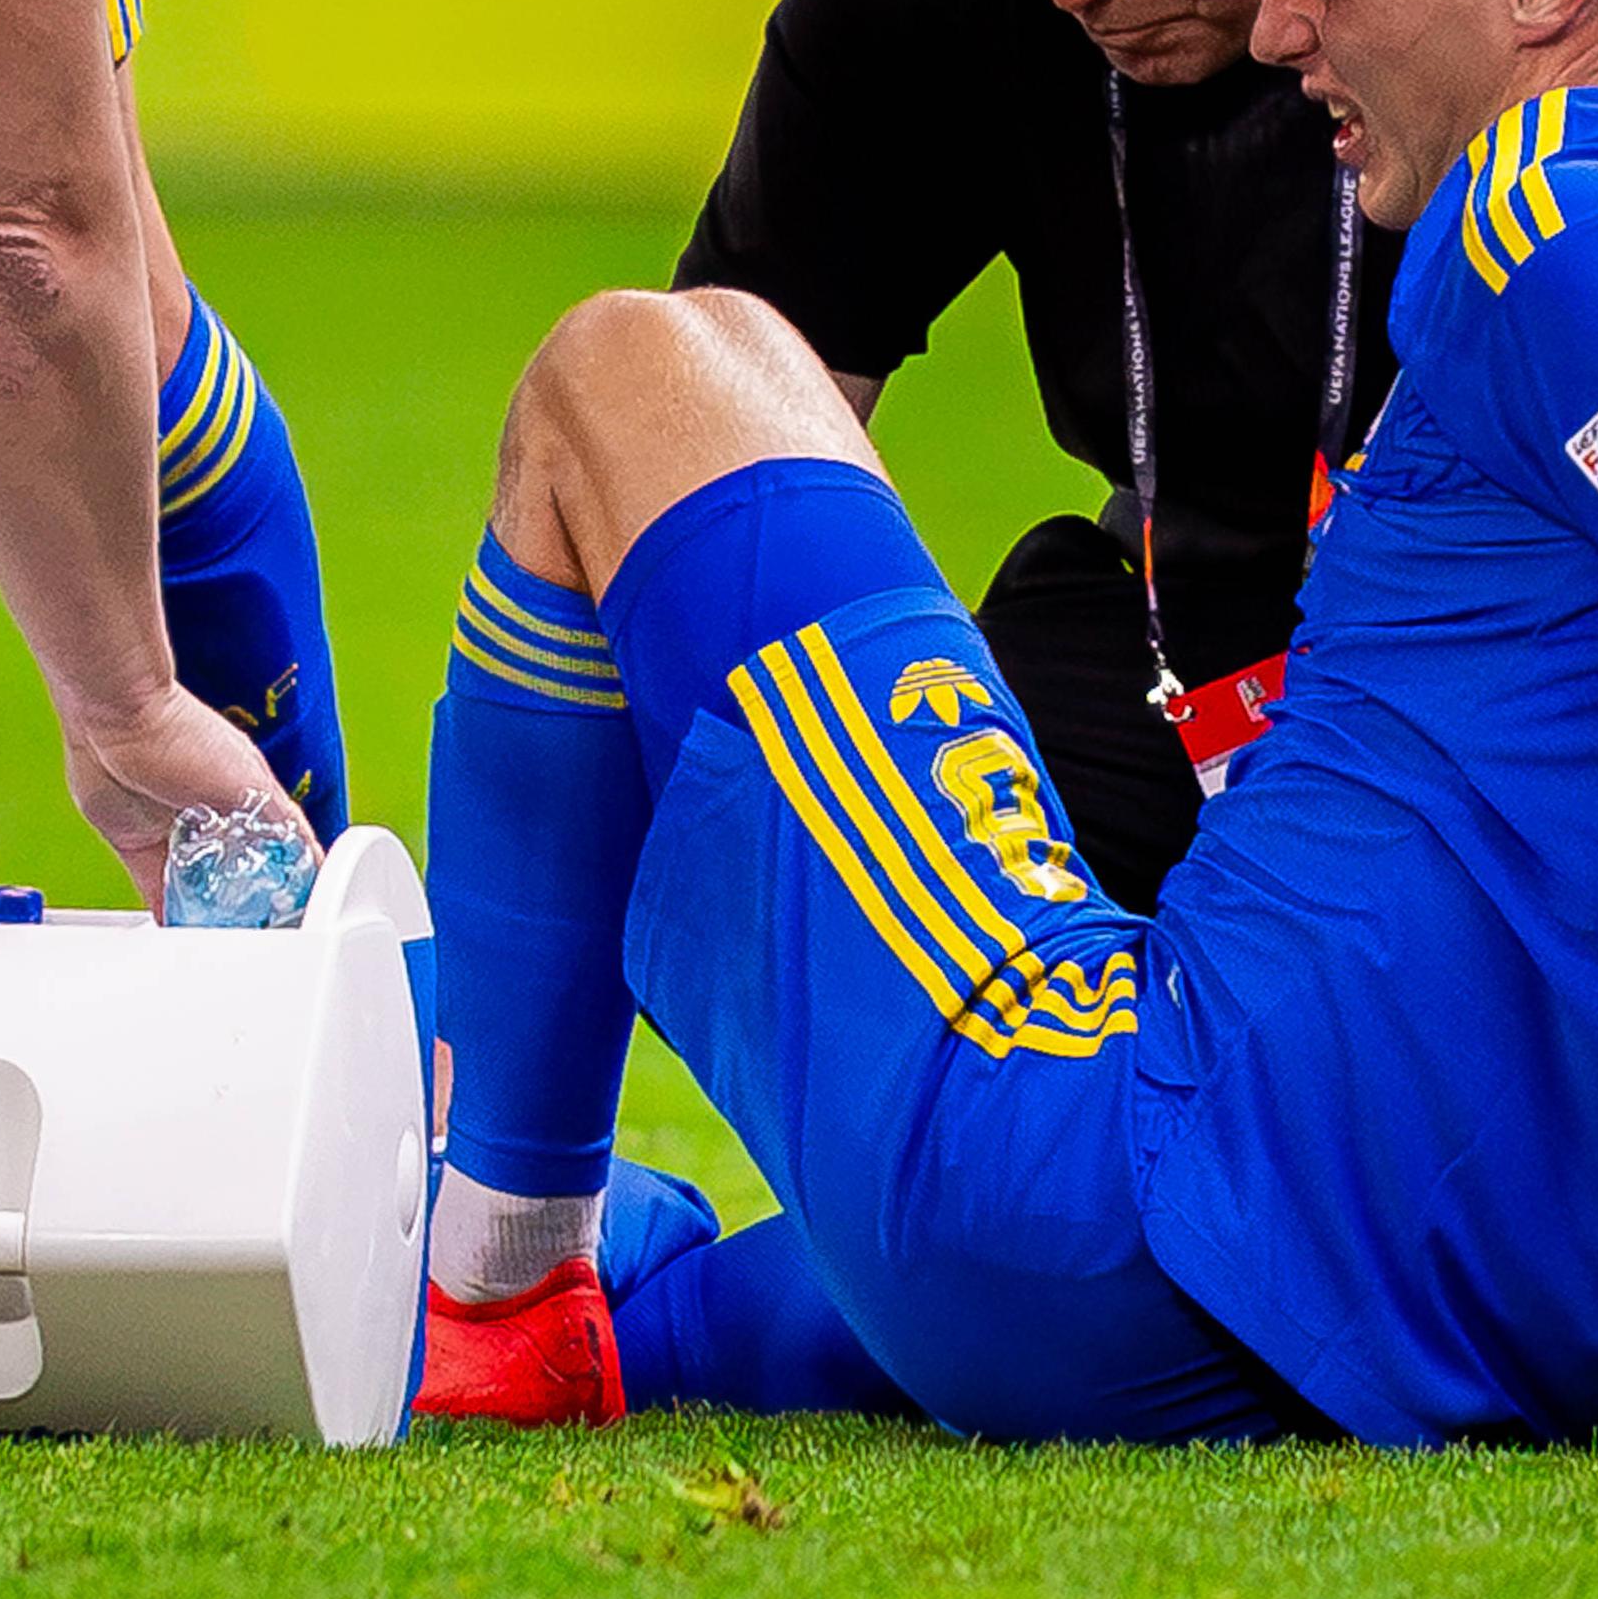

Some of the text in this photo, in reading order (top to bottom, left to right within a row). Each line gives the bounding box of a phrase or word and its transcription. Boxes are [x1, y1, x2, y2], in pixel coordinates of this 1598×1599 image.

[1329, 175, 1357, 405] UEFA NATIONS LEAGUE
[1129, 320, 1147, 411] NATIONS
[1131, 412, 1147, 466] UEFA
